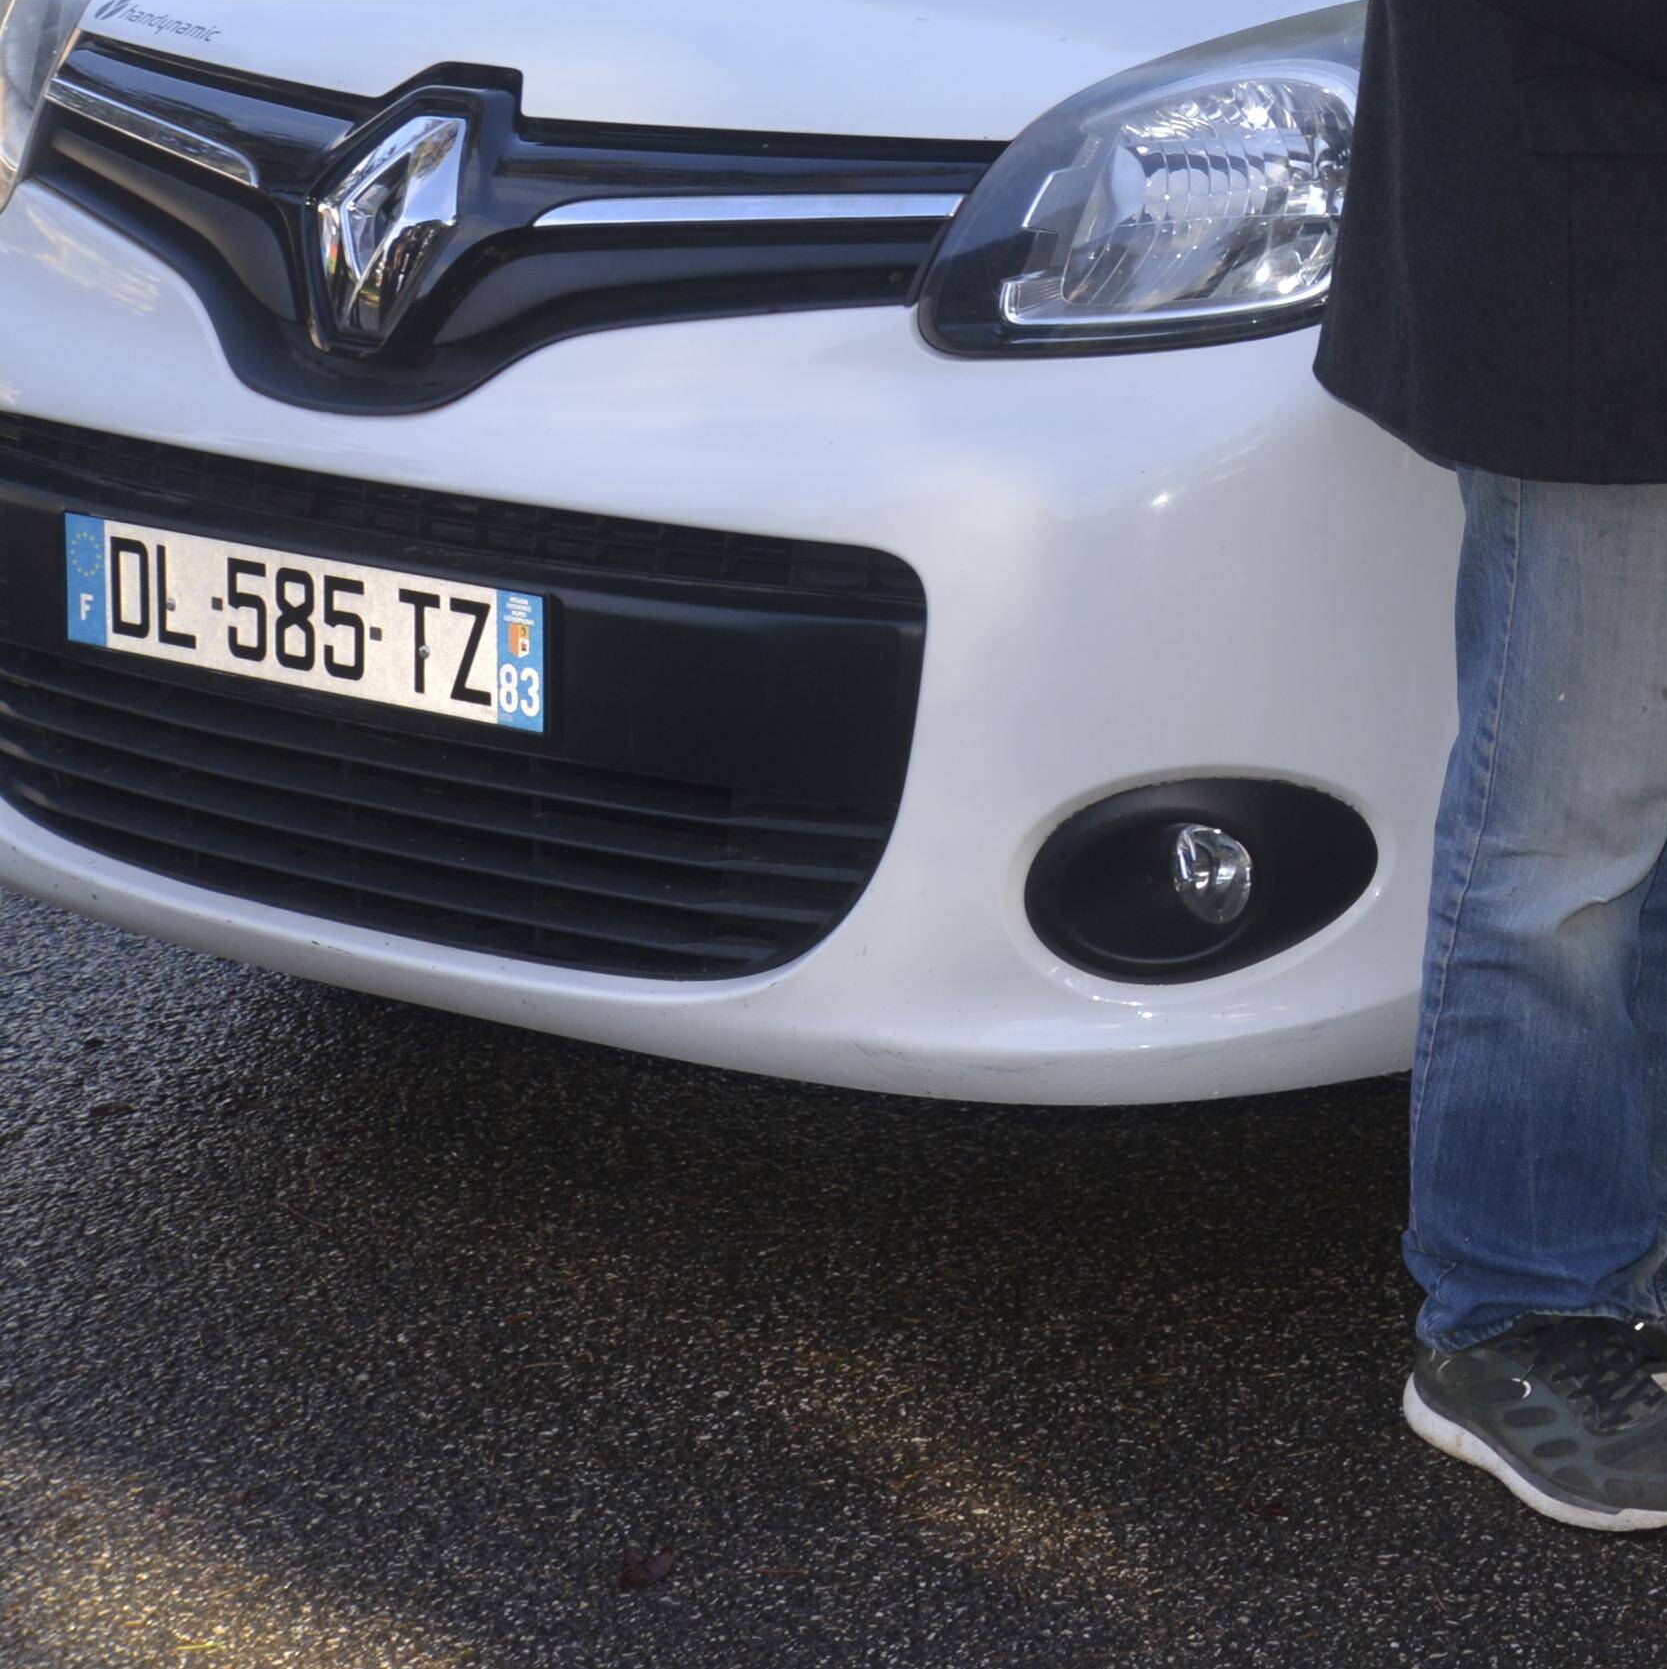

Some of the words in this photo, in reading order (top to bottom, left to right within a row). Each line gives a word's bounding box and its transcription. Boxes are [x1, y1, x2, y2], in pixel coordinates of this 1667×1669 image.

[120, 5, 220, 41] handynamic
[80, 593, 94, 622] F
[500, 664, 540, 717] 83
